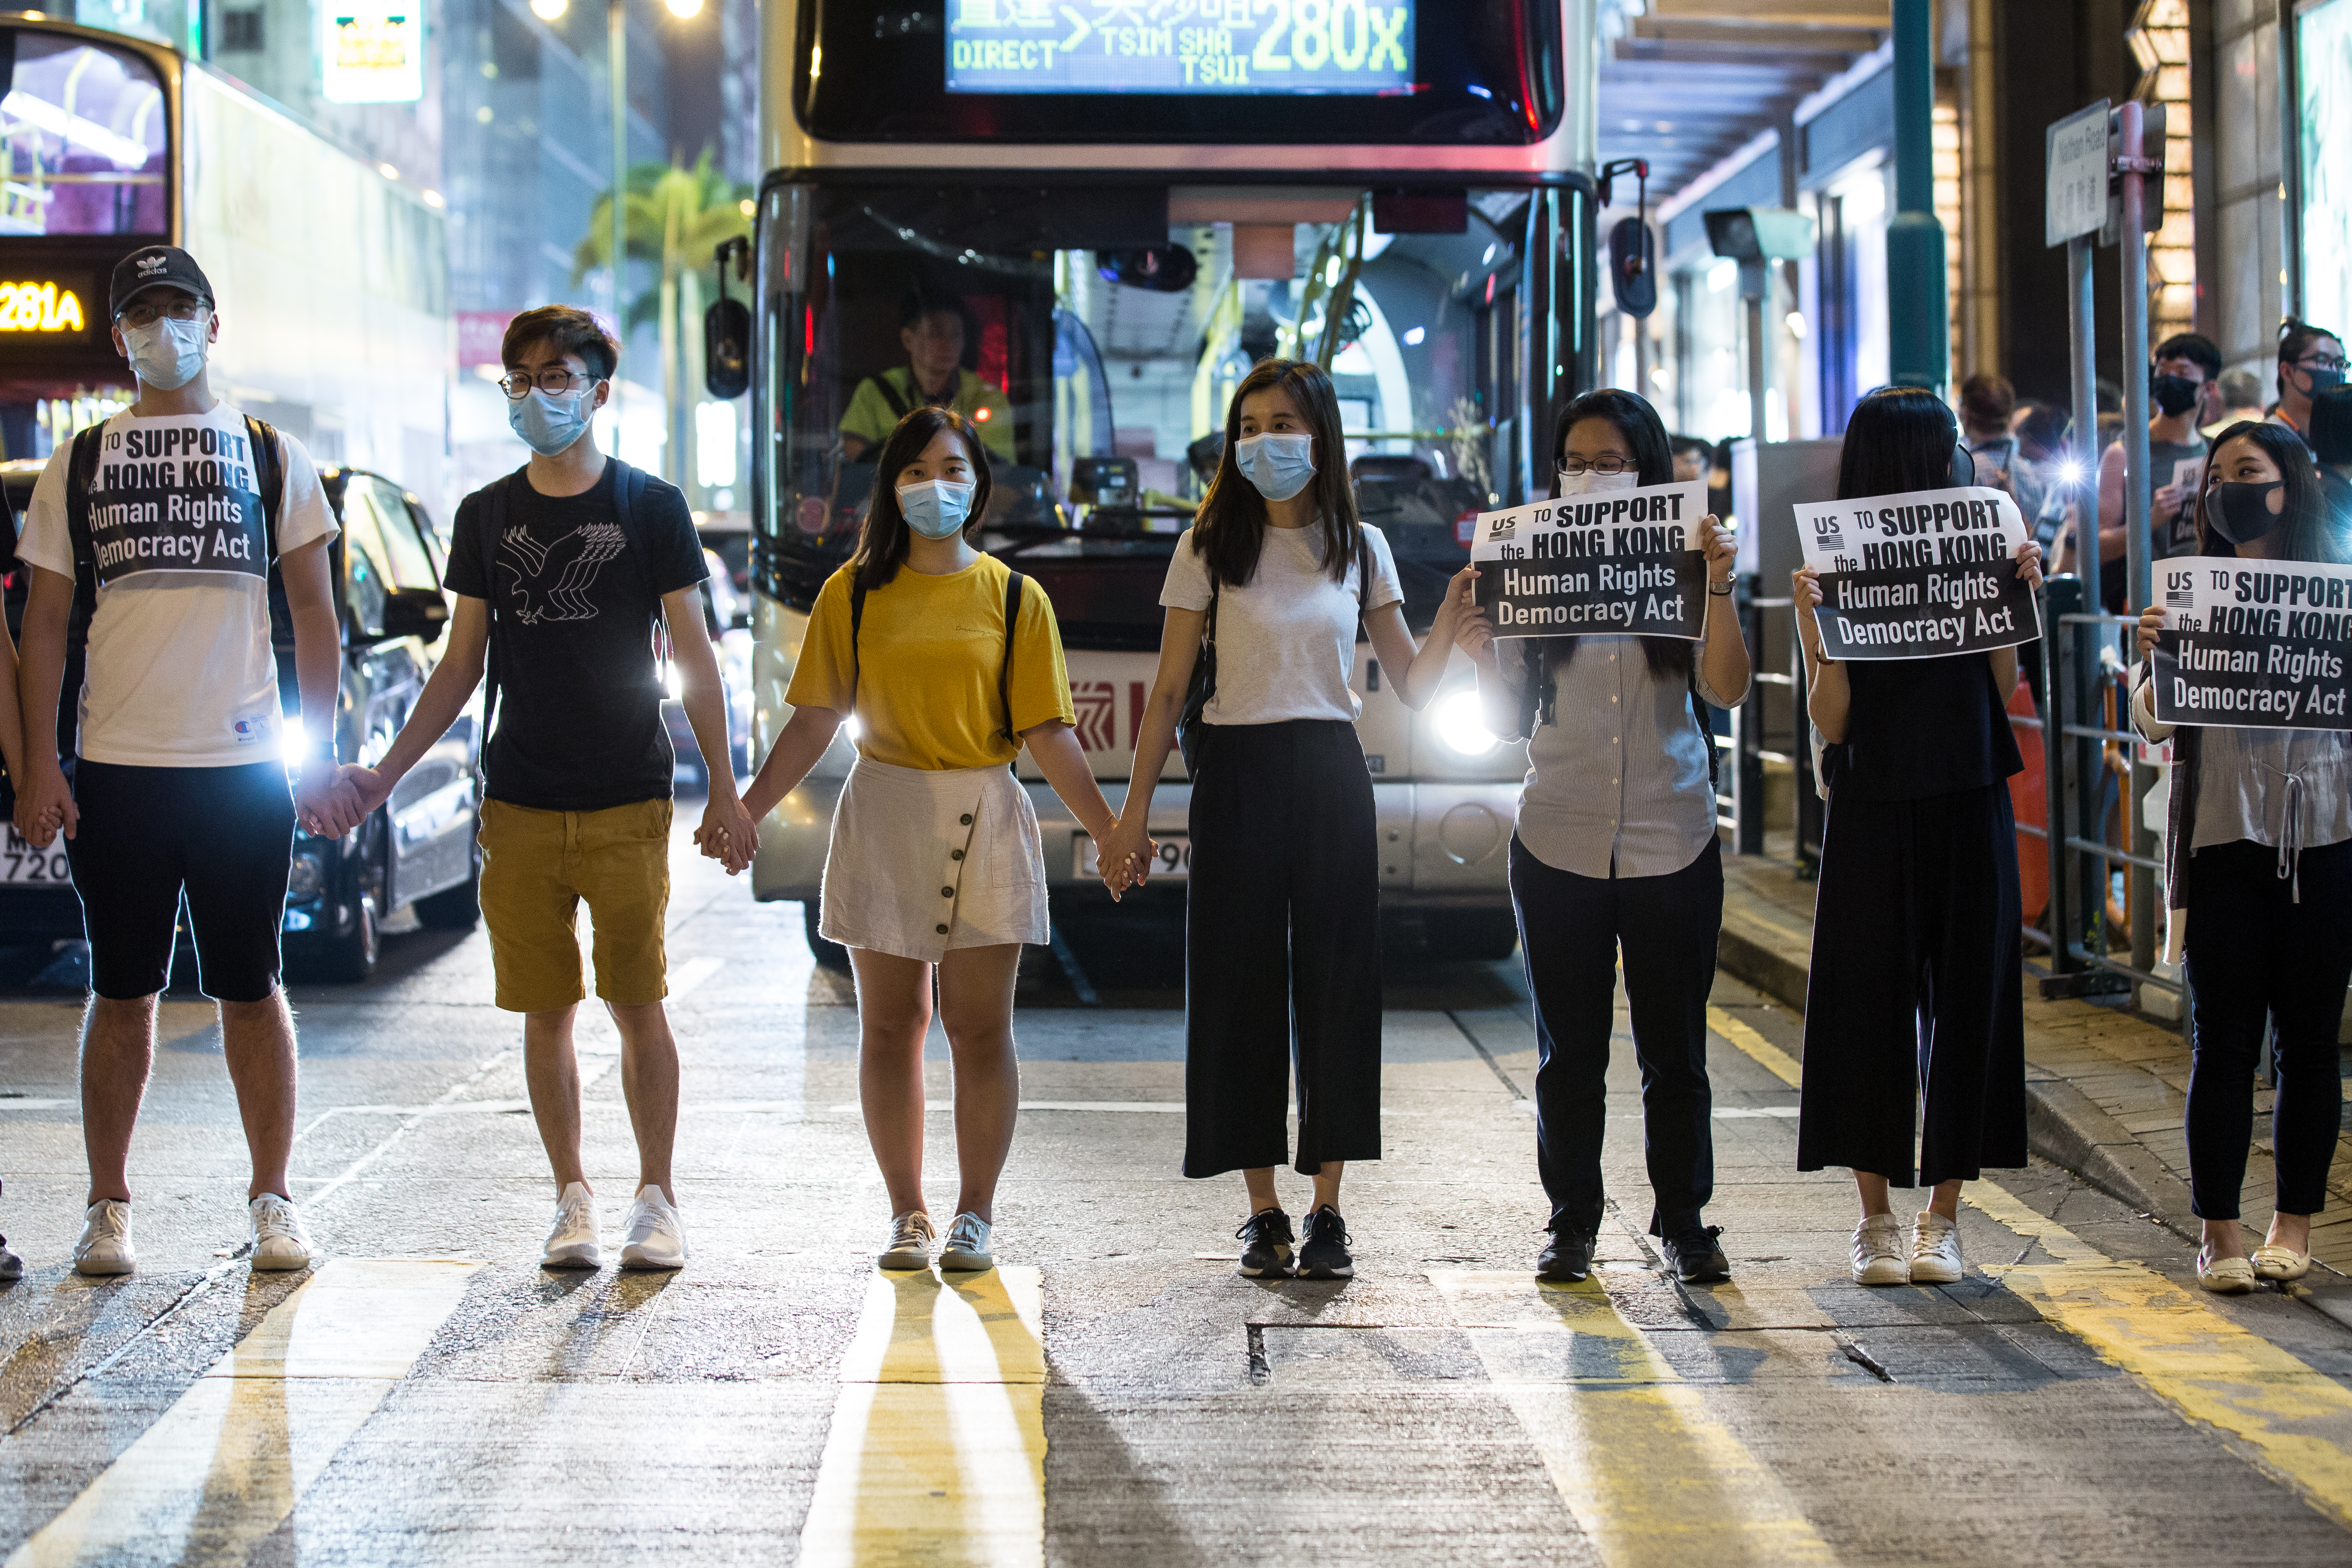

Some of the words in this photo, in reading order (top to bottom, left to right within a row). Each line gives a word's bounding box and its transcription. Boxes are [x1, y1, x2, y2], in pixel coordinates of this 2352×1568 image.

[1098, 27, 1172, 56] TSIM
[1178, 27, 1232, 56] SHA
[1252, 0, 1408, 71] 280X
[953, 39, 1058, 70] DIRECT
[1178, 55, 1250, 85] TSUI
[138, 266, 167, 278] adidas
[0, 281, 84, 332] 281A
[105, 432, 120, 451] TO
[126, 427, 245, 462] SUPPORT
[103, 461, 175, 490] HONG
[183, 460, 249, 491] KONG
[87, 501, 158, 532] Human
[168, 493, 243, 529] Rights
[1492, 516, 1517, 532] US
[1533, 508, 1552, 523] TO
[1556, 493, 1684, 528] SUPPORT
[1813, 516, 1840, 535] US
[1853, 510, 1874, 530] TO
[1878, 499, 2000, 537] SUPPORT
[93, 535, 205, 570] Democracy
[212, 528, 250, 560] Act
[1500, 543, 1525, 560] the
[1532, 529, 1606, 559] HONG
[1613, 525, 1685, 555] KONG
[1834, 555, 1858, 572] the
[1862, 539, 1933, 570] HONG
[1939, 532, 2007, 564] KONG
[1503, 568, 1590, 596] Human
[1599, 562, 1676, 595] Rights
[1838, 580, 1919, 610] Human
[1927, 571, 1999, 609] Rights
[2167, 572, 2193, 591] US
[2210, 570, 2230, 590] TO
[1498, 600, 1637, 627] Democracy
[1644, 593, 1684, 622] Act
[1836, 616, 1965, 646] Democracy
[1975, 606, 2015, 637] Act
[2178, 613, 2202, 632] the
[2208, 605, 2281, 635] HONG
[2287, 610, 2352, 641] KONG
[2178, 639, 2260, 673] Human
[2267, 644, 2343, 684] Rights
[2174, 677, 2301, 721] Democracy
[2305, 684, 2346, 715] Act
[4, 854, 69, 881] 720
